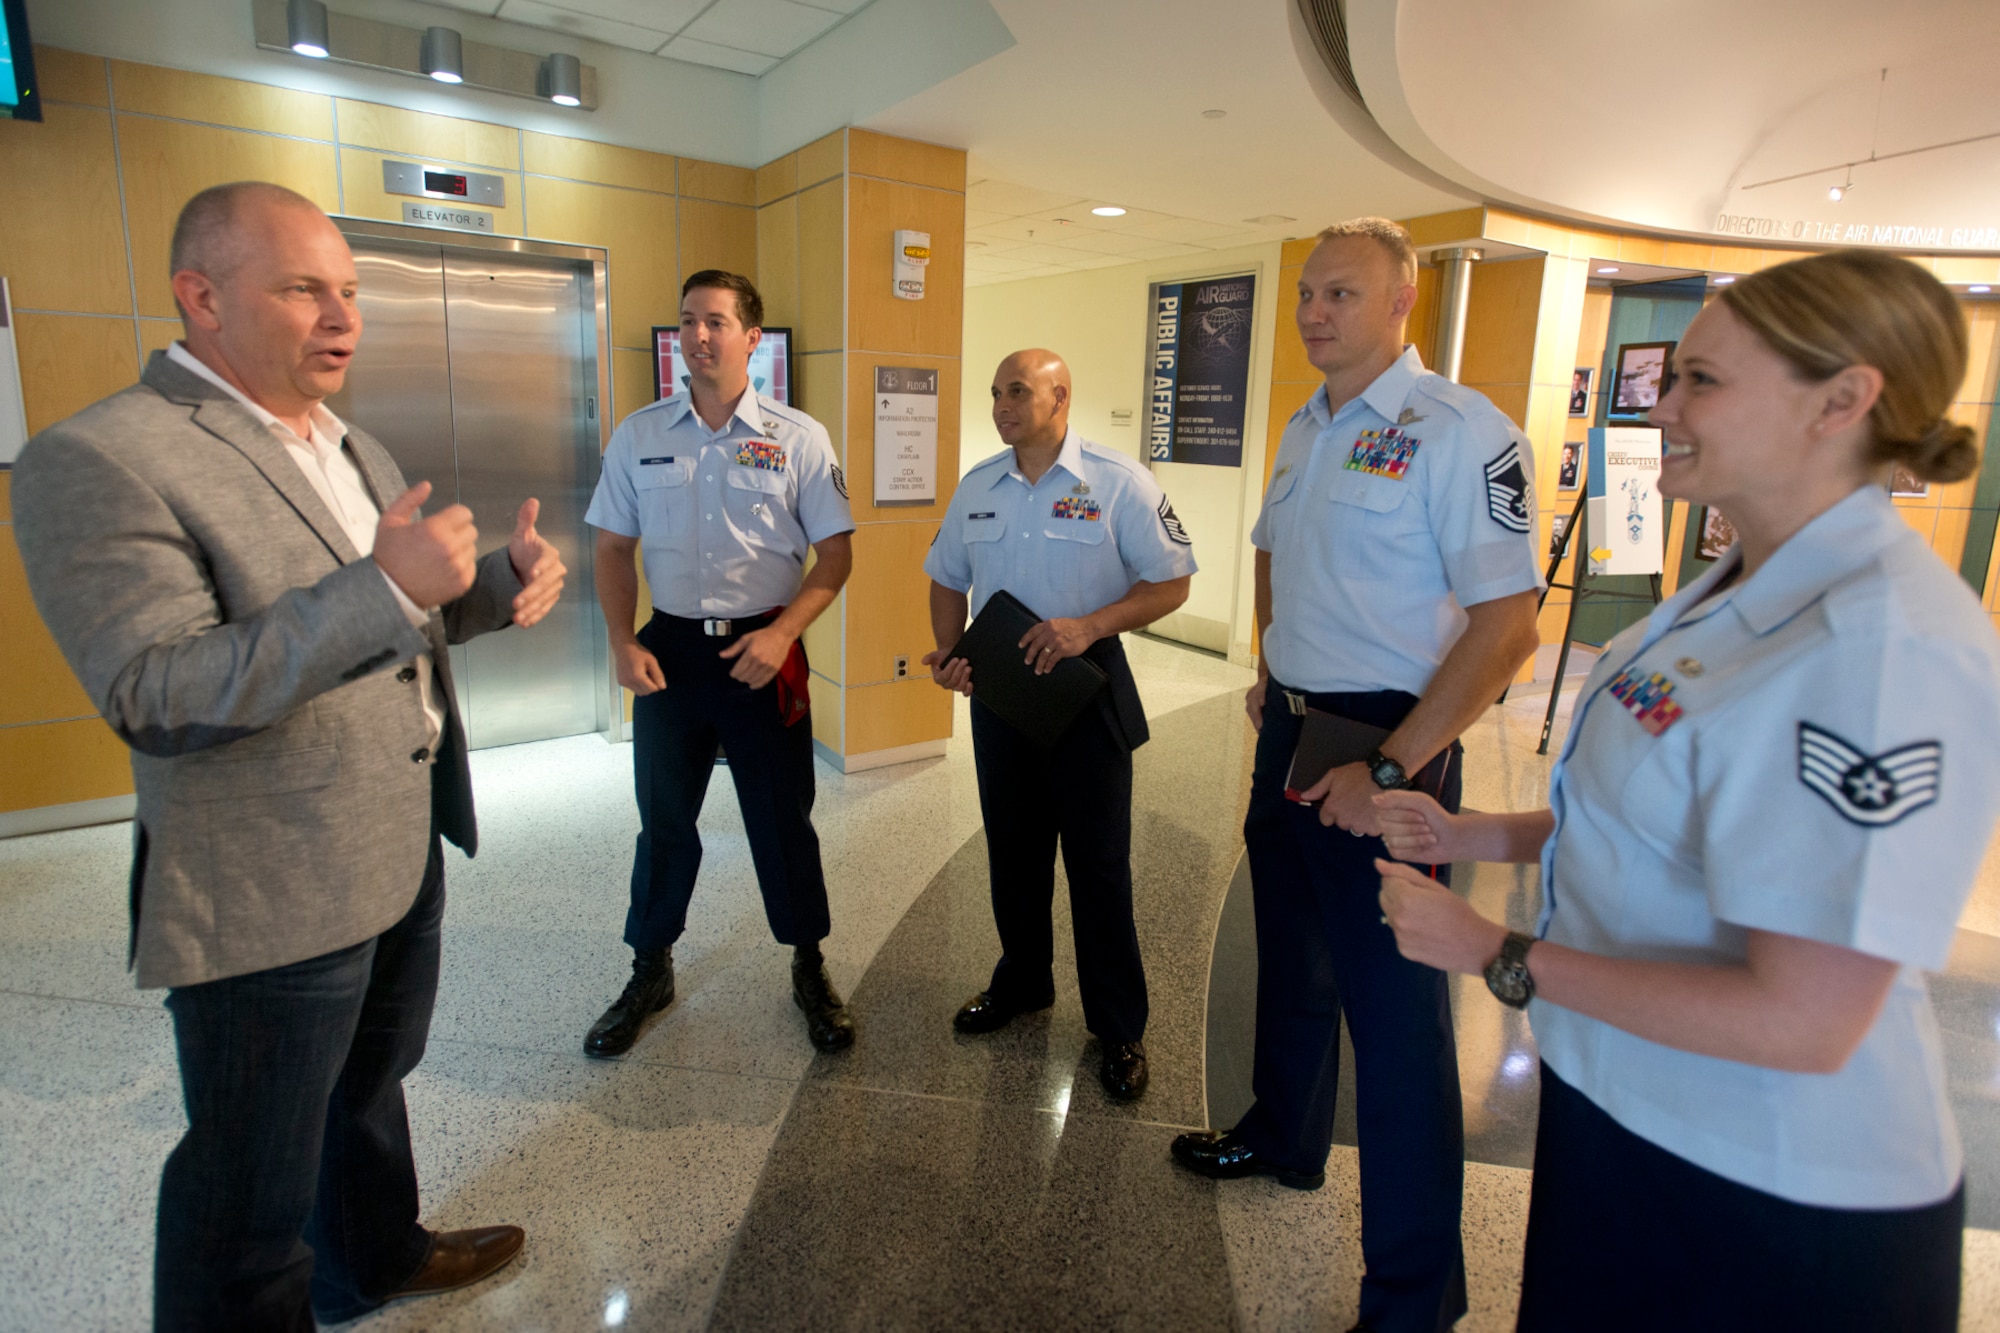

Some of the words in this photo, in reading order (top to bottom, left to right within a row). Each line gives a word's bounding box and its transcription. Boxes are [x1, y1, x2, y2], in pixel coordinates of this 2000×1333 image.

[454, 175, 466, 195] 3
[412, 208, 471, 224] ELEVATOR
[478, 217, 486, 227] 2
[1717, 213, 1790, 238] DIRECTORS
[1792, 220, 1812, 239] OF
[1815, 221, 1843, 241] THE
[1843, 223, 1869, 243] AIR
[1871, 224, 1945, 247] NATIONAL
[1950, 226, 2000, 248] GUAR
[1195, 285, 1220, 305] AIR
[1219, 290, 1250, 303] GUARD
[1155, 296, 1178, 369] PUBLIC
[907, 380, 928, 391] FLOOR
[928, 374, 935, 391] 1
[906, 407, 914, 415] A2
[1151, 376, 1173, 458] AFFAIRS
[904, 445, 913, 453] HC
[1608, 457, 1659, 465] EXECUTIVE
